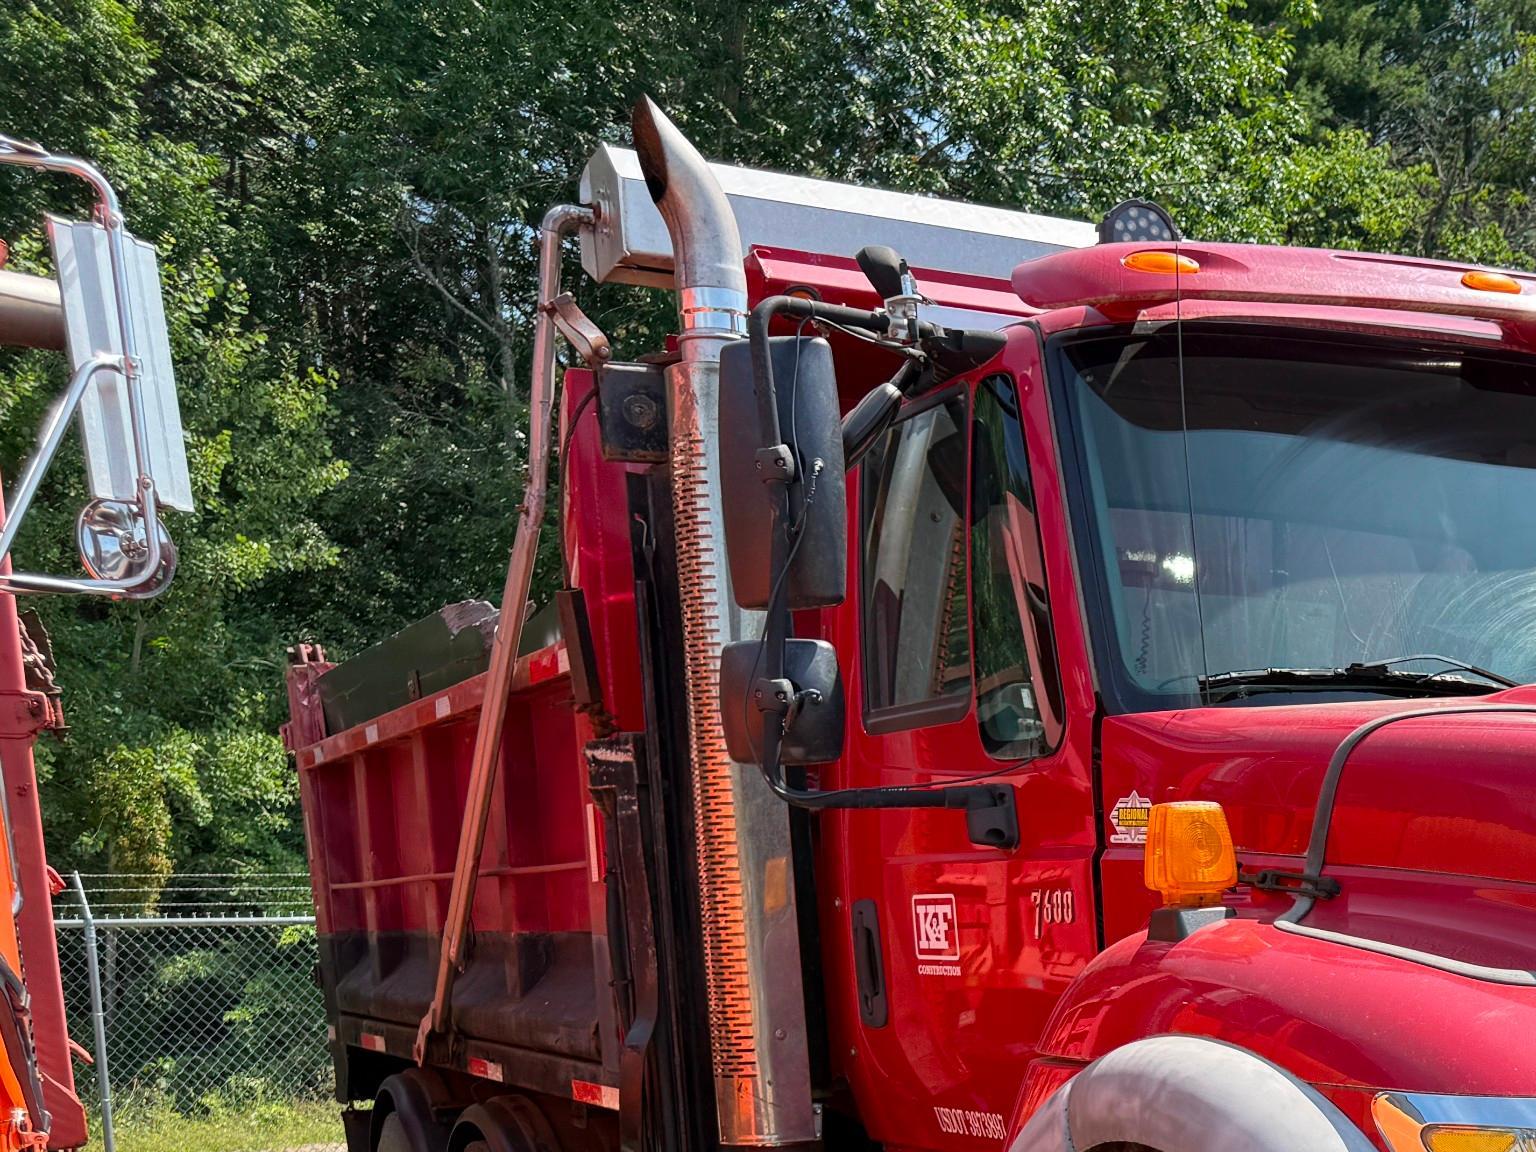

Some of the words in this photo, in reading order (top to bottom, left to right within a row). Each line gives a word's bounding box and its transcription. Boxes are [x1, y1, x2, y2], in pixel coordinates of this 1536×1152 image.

[916, 904, 953, 950] K&F
[1031, 889, 1073, 940] 7600
[917, 964, 962, 977] CONSTRUCTION
[933, 1106, 969, 1136] USDOT
[965, 1110, 1008, 1140] 3973897
